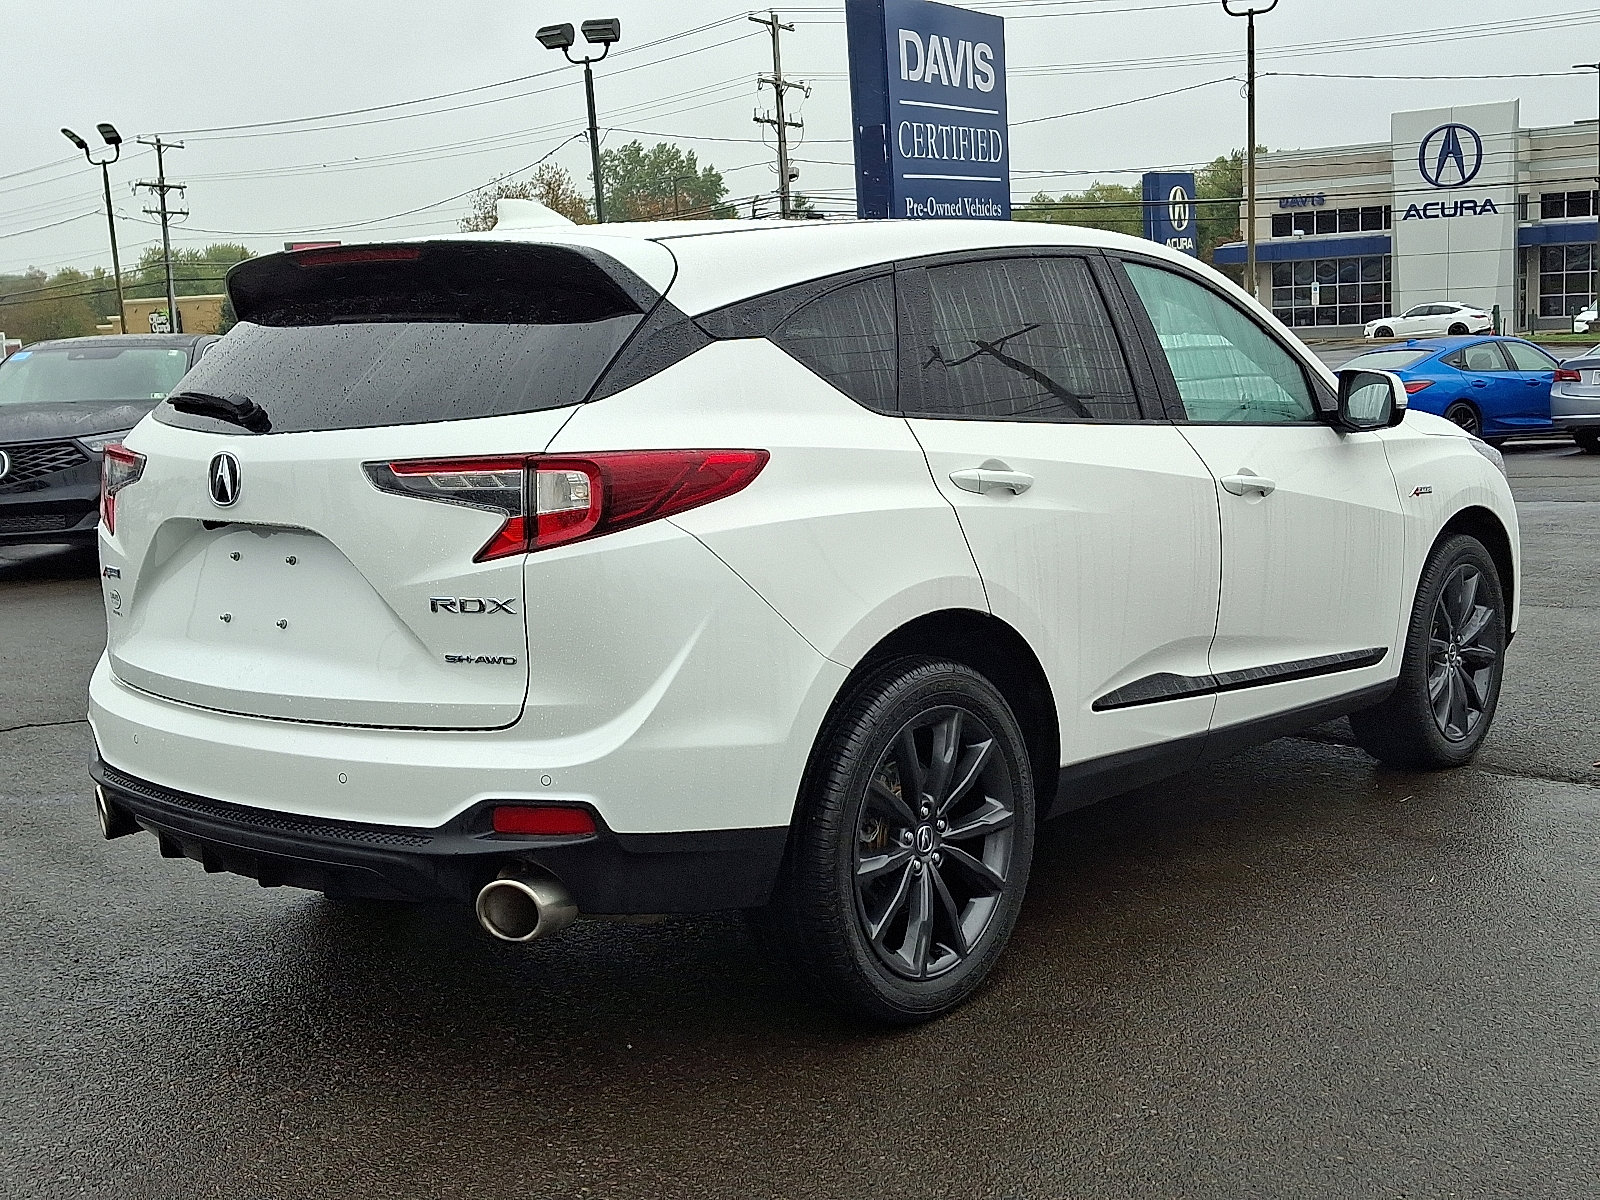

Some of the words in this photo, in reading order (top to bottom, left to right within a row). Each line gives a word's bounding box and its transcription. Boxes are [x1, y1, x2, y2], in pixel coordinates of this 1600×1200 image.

[898, 28, 996, 93] DAVIS
[898, 120, 1003, 164] CERTIFIED
[905, 196, 963, 217] Pre-Owned
[963, 197, 1002, 217] Vehicles
[1402, 198, 1499, 220] ACURA
[1166, 237, 1194, 250] ACURA
[430, 596, 518, 615] RDX
[444, 653, 518, 666] SH-AWD
